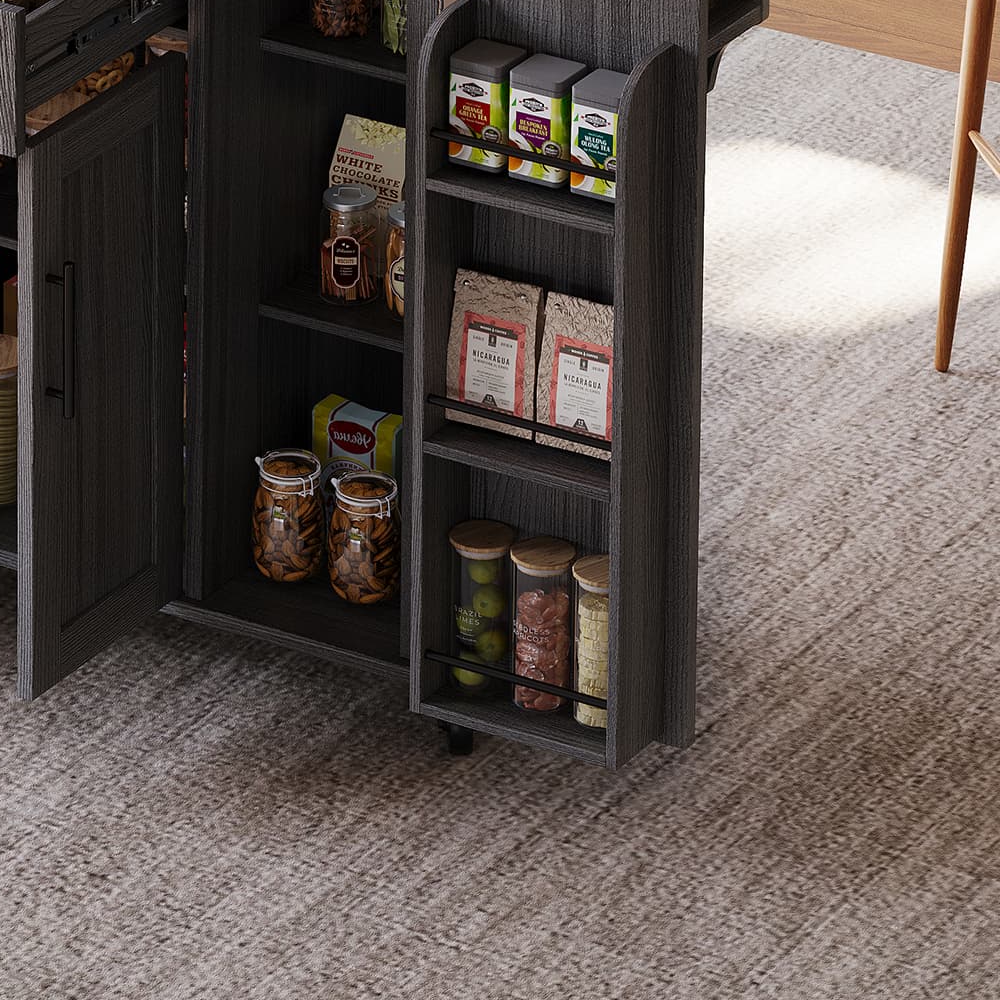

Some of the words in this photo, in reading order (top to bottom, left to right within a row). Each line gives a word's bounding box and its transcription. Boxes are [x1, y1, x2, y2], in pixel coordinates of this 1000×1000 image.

[336, 153, 383, 173] WHITE
[332, 174, 399, 199] CHKS
[333, 165, 401, 188] CHOCOLATE
[472, 349, 510, 366] NICARAGUA
[563, 373, 602, 390] NICARAGUA
